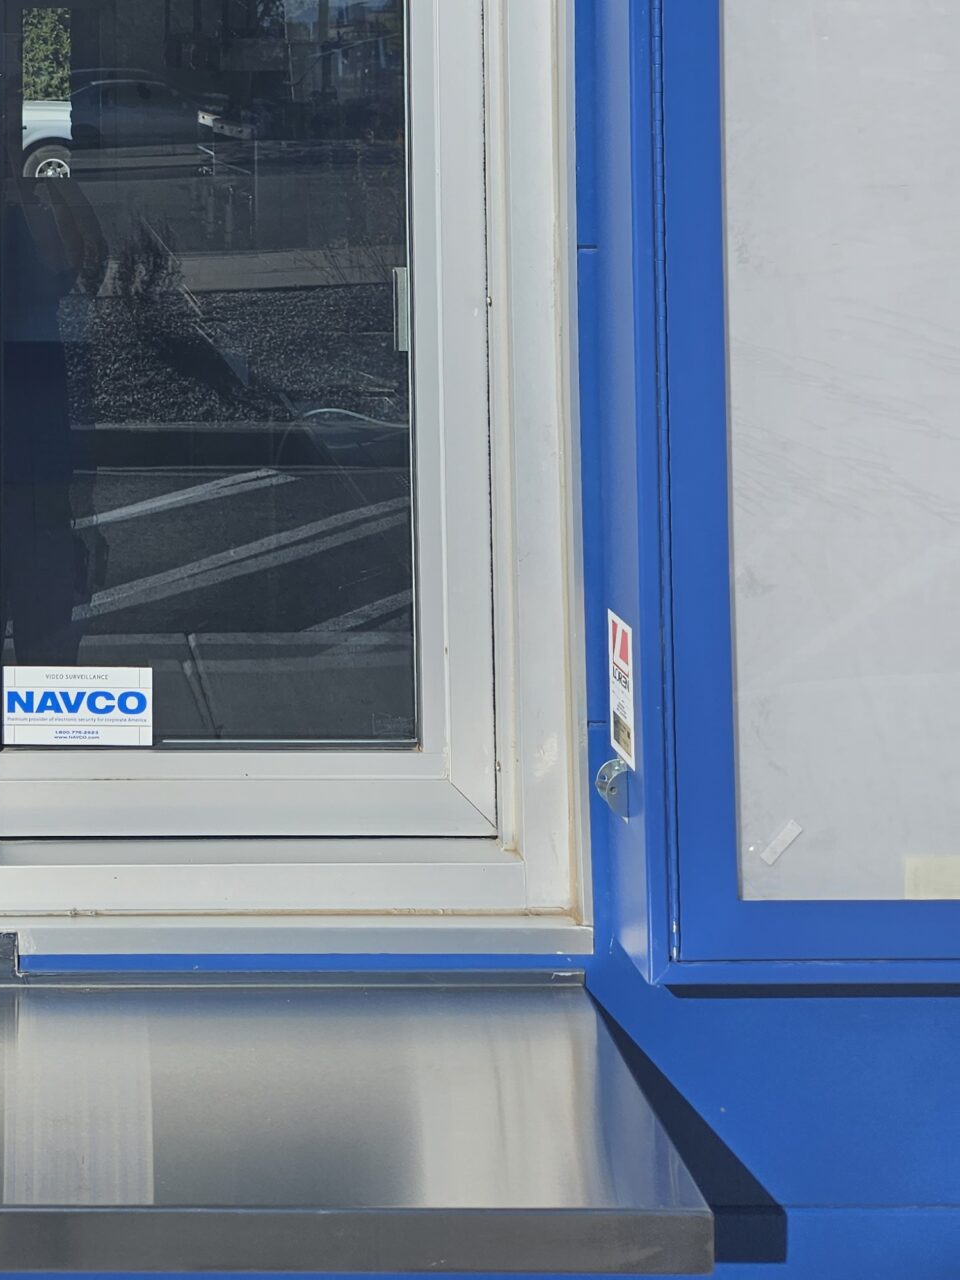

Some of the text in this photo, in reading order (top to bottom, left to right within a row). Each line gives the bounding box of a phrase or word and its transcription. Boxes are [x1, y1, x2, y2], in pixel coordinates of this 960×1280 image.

[44, 673, 109, 681] VIDEO SURVEILLANCE
[7, 691, 147, 715] NAVCO
